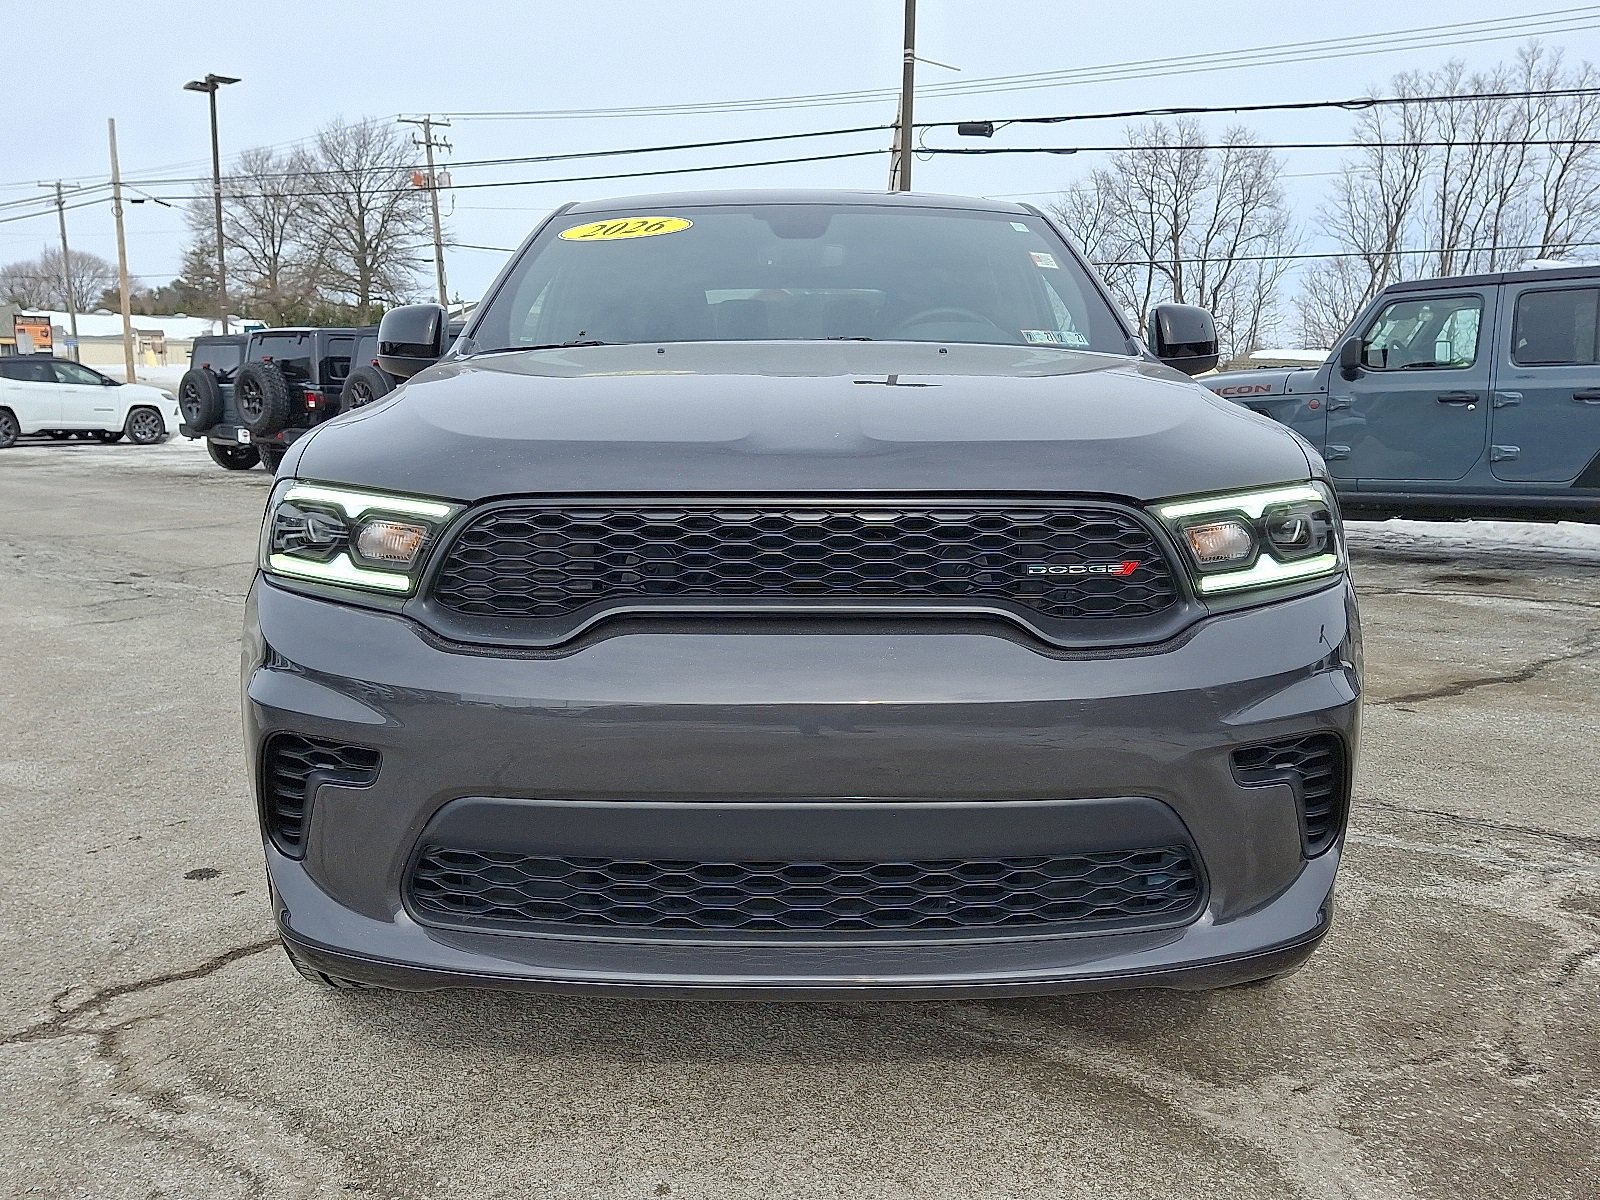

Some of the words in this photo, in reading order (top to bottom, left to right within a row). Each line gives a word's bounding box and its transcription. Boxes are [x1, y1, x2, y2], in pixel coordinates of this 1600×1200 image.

[578, 219, 671, 239] 2026
[1211, 384, 1272, 396] ICON
[1028, 565, 1125, 575] DODGE
